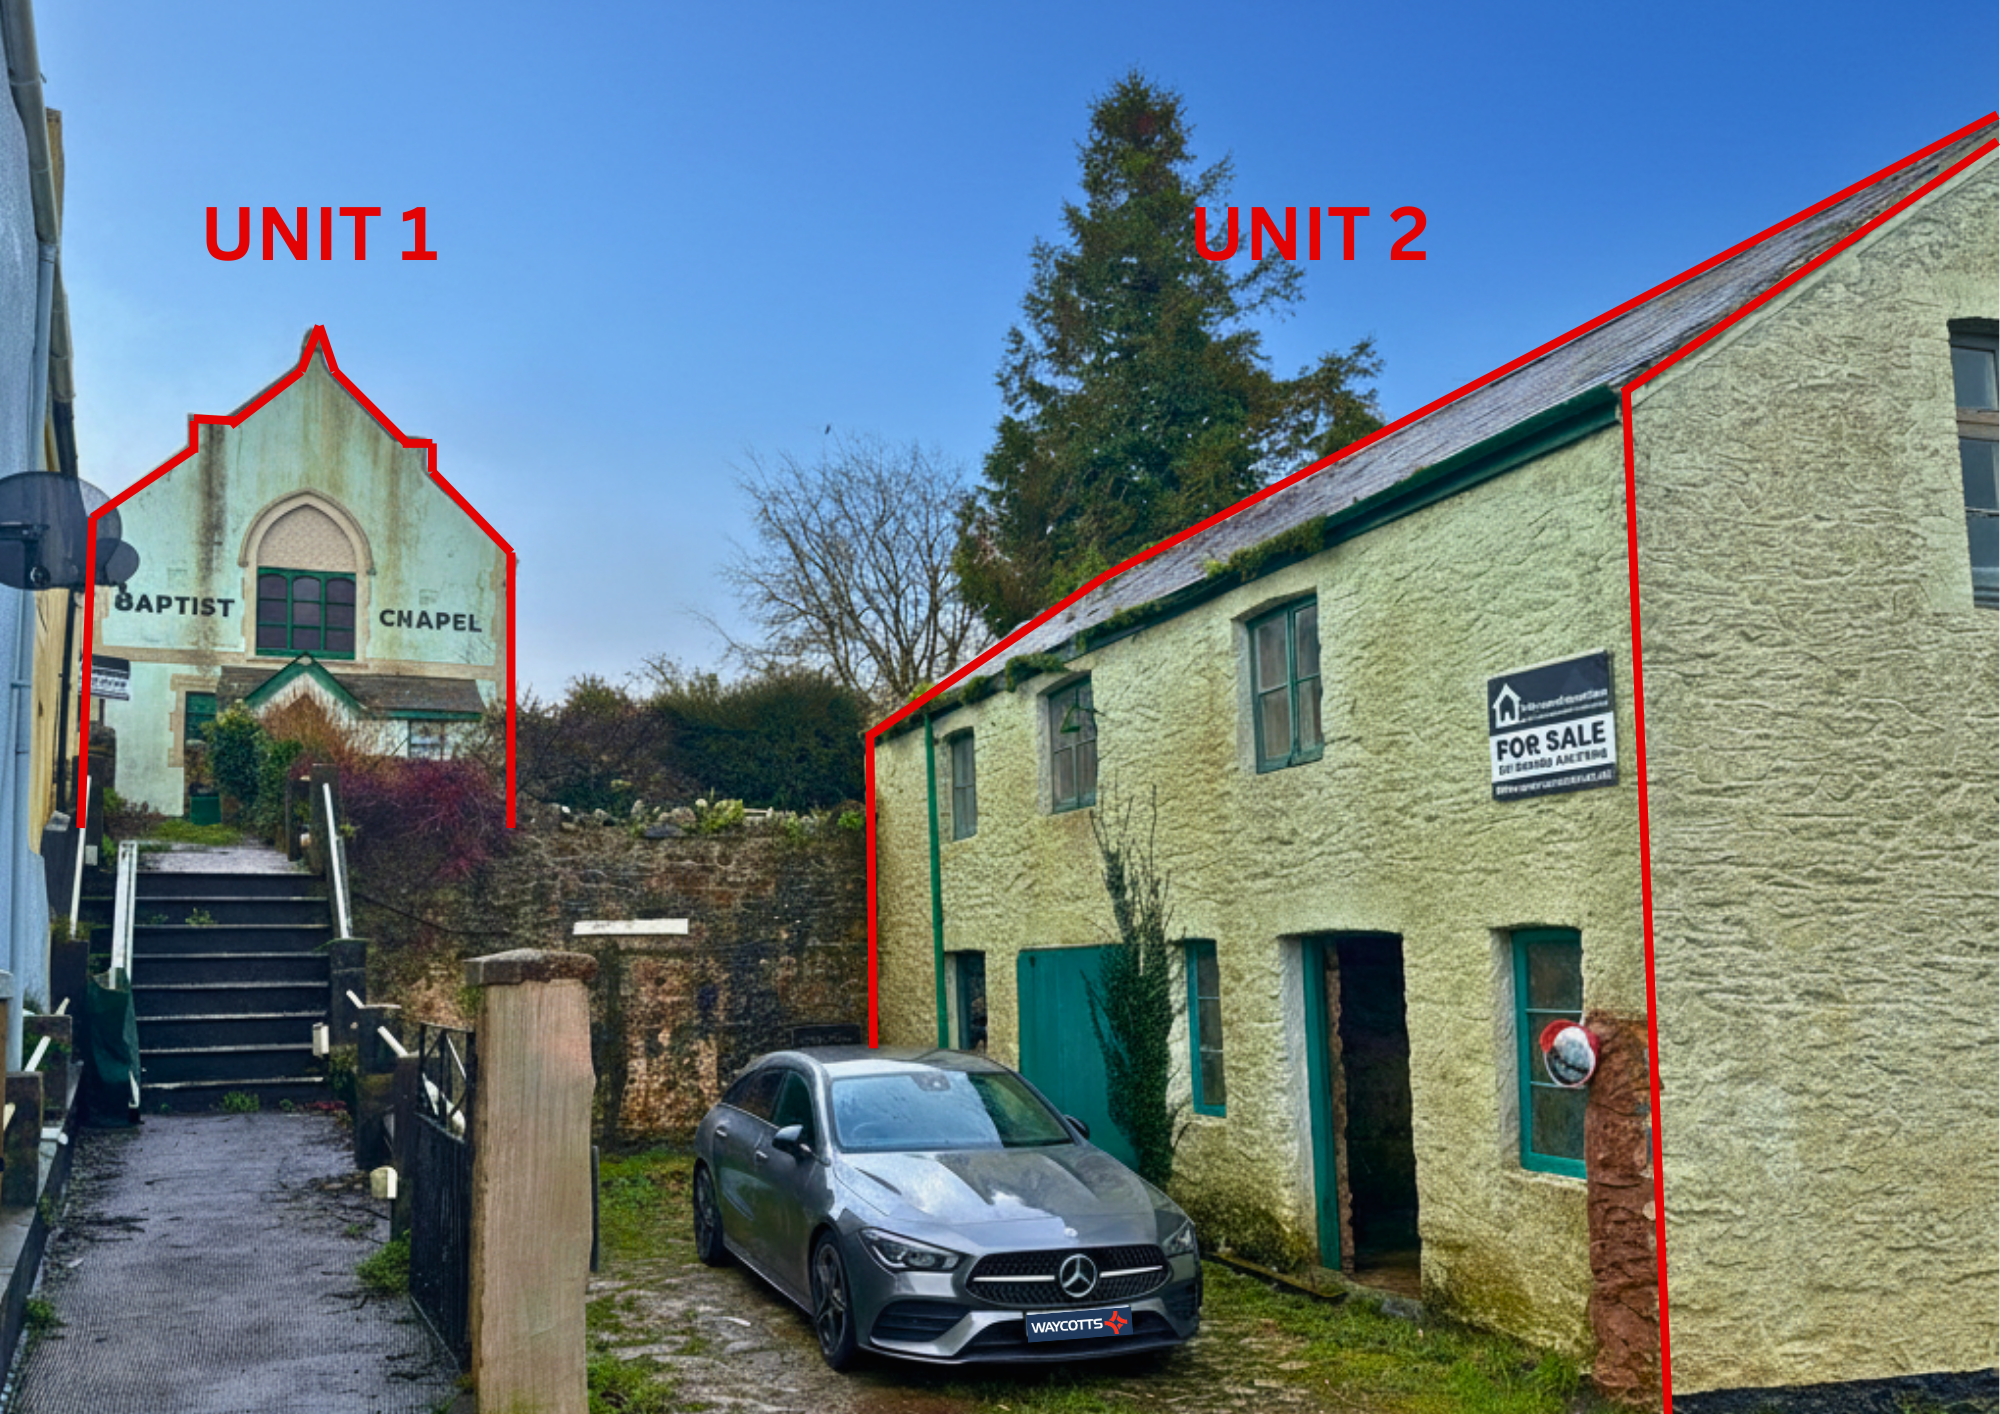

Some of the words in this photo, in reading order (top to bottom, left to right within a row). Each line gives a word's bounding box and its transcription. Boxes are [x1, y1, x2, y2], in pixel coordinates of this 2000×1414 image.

[114, 592, 235, 617] BAPTIST
[1496, 734, 1541, 762] FOR
[1546, 720, 1607, 751] SALE
